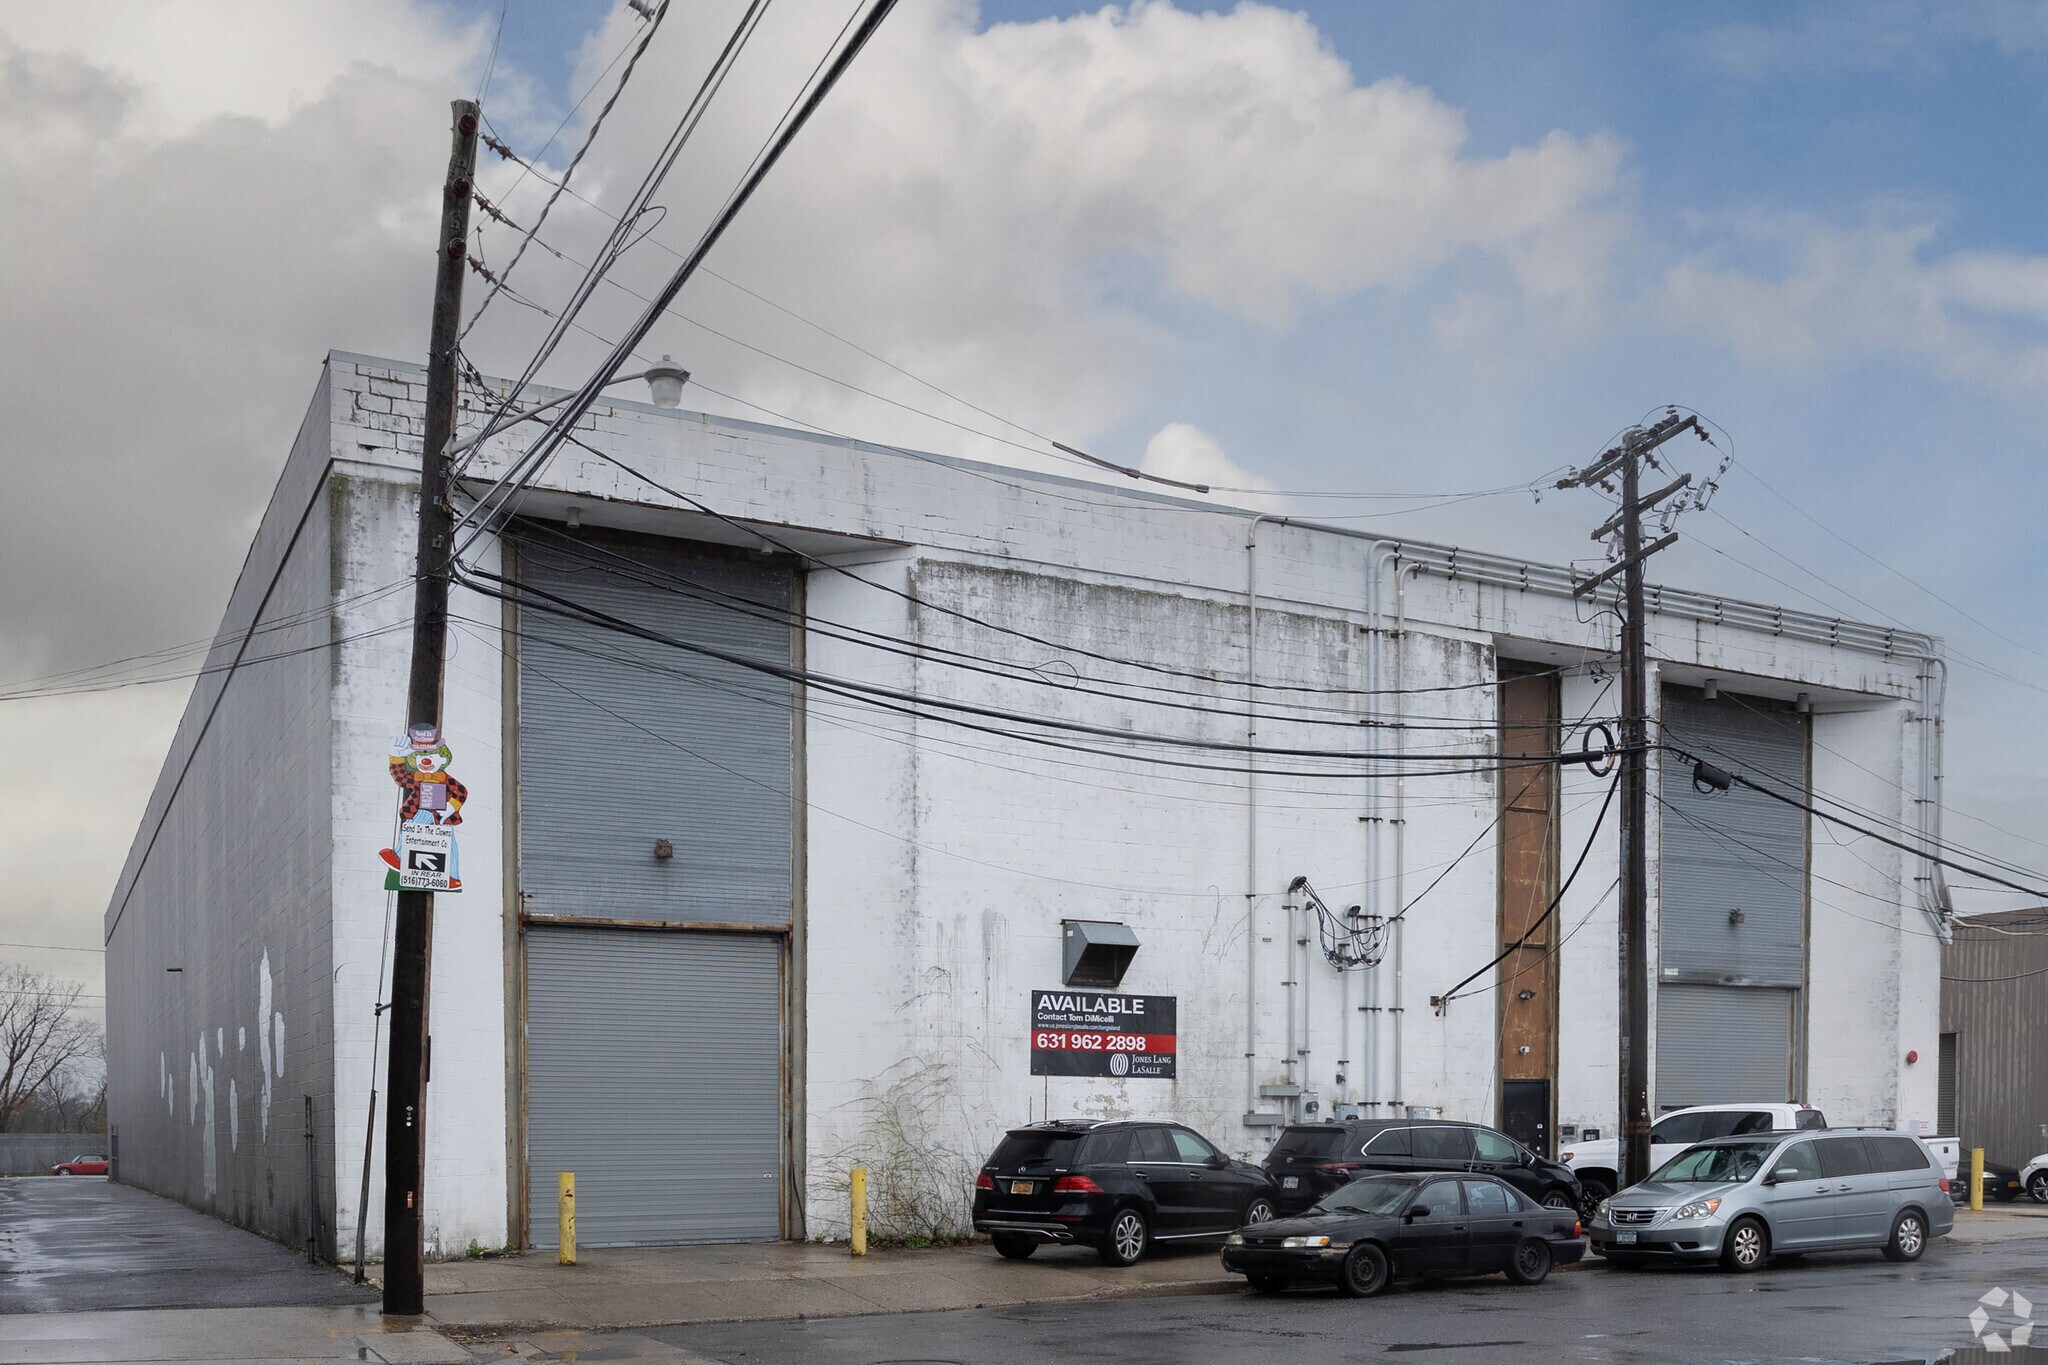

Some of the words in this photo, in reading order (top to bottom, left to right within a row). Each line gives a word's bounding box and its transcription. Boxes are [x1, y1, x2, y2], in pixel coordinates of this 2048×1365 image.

[402, 823, 415, 833] Send
[416, 825, 423, 833] In
[425, 825, 434, 835] The
[435, 827, 452, 837] Clowns
[405, 834, 440, 847] Entertainment
[440, 839, 450, 849] Co.
[420, 870, 442, 878] REAR
[400, 875, 448, 888] (516)773-6060
[1037, 994, 1145, 1014] AVAILABLE
[1037, 1012, 1067, 1021] Contact
[1068, 1013, 1084, 1022] Tom
[1084, 1014, 1115, 1023] DiMicelli
[1036, 1033, 1067, 1049] 631
[1071, 1034, 1102, 1050] 962
[1106, 1035, 1147, 1051] 2898
[1131, 1054, 1152, 1065] JONES
[1153, 1054, 1172, 1064] LANG
